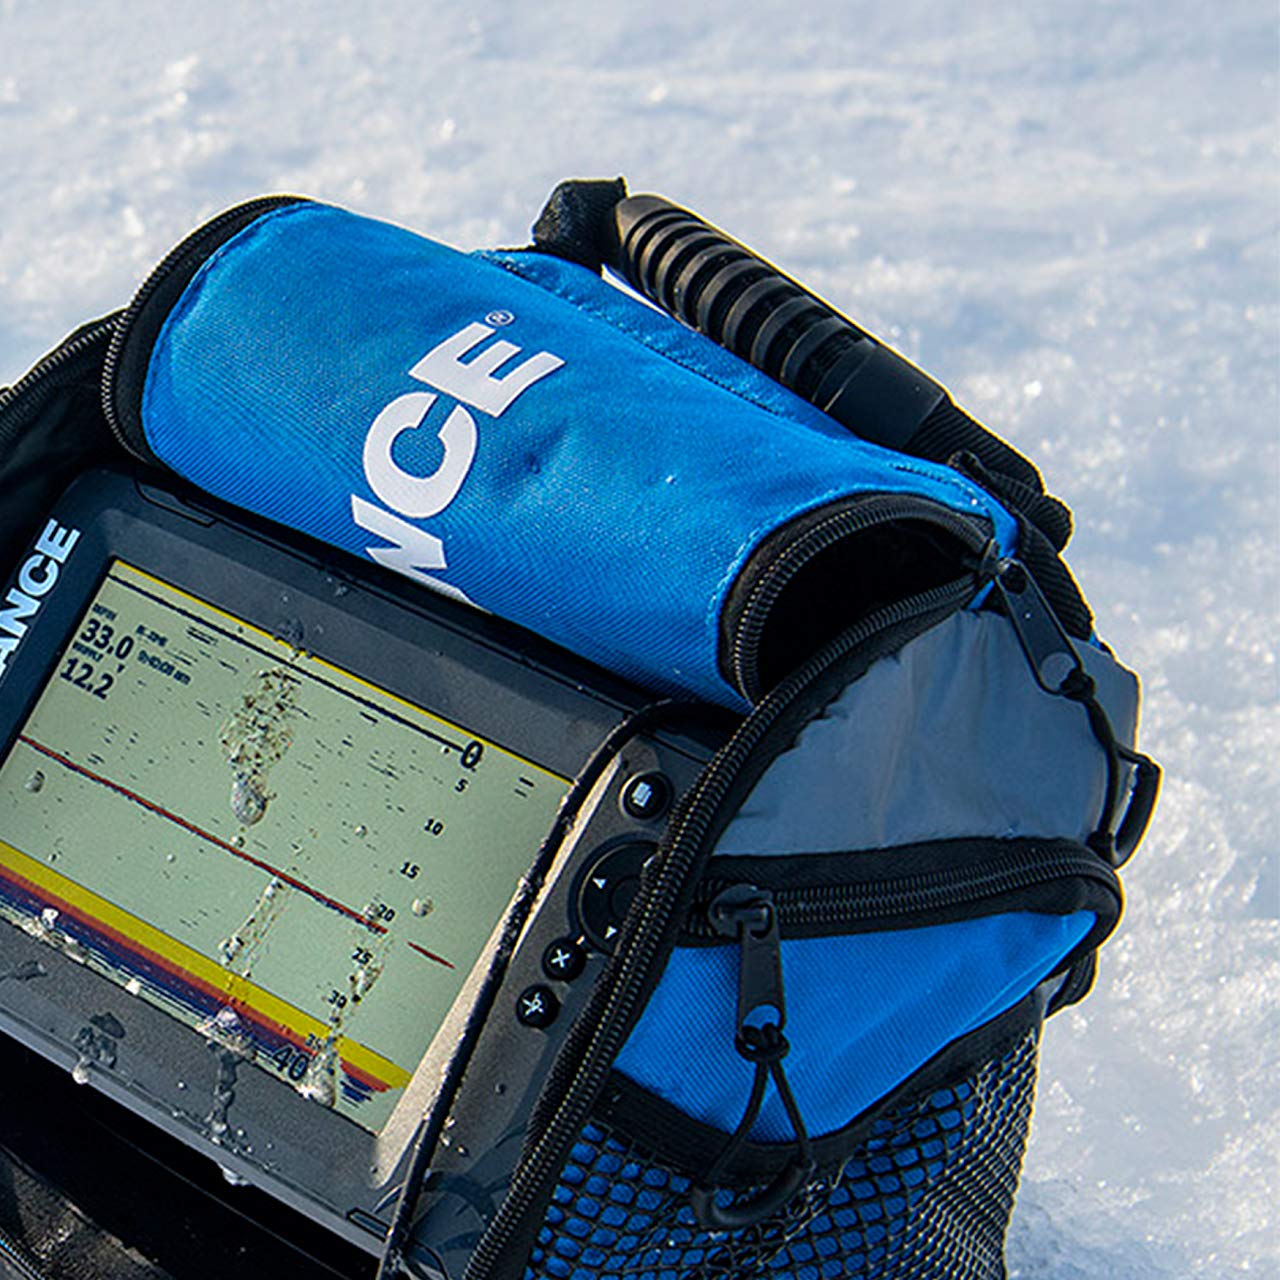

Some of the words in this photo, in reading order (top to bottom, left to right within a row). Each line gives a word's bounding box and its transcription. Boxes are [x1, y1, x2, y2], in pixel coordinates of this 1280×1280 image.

[80, 618, 134, 660] 33.0
[60, 658, 114, 700] 12.2
[460, 740, 484, 769] 0
[454, 778, 469, 793] 5
[424, 818, 444, 836] 10
[400, 861, 420, 880] 15
[376, 903, 396, 922] 20
[327, 989, 348, 1009] 30
[271, 1045, 310, 1081] 40
